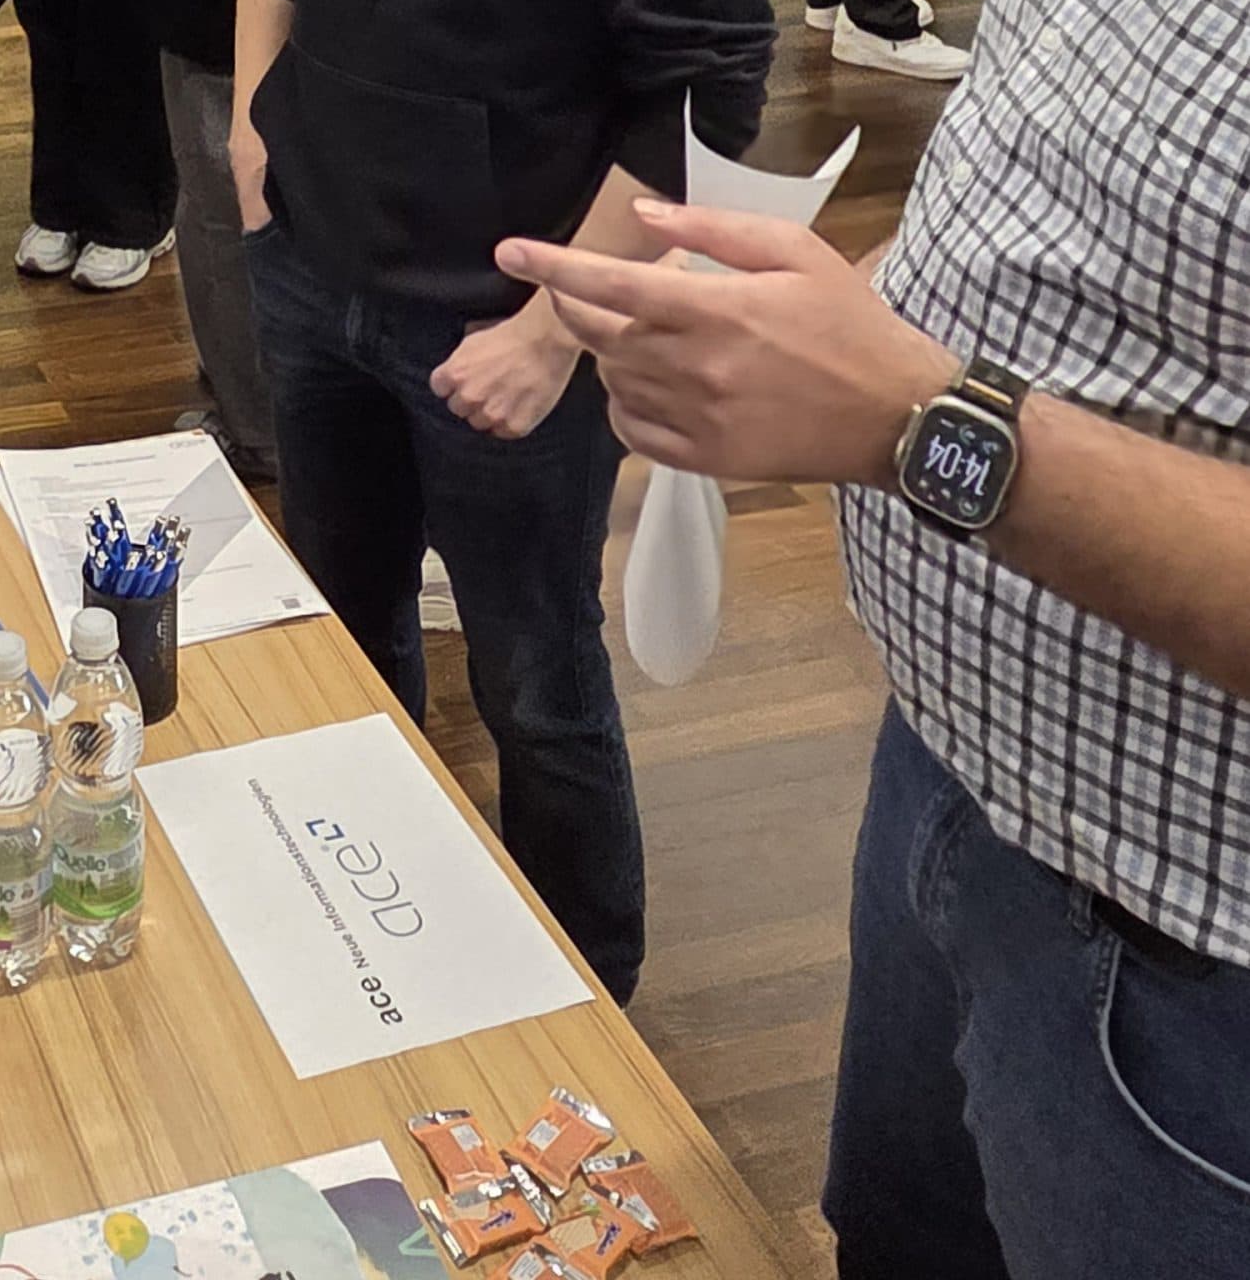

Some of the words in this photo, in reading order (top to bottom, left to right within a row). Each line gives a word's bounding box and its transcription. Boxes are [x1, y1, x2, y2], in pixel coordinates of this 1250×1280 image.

[924, 433, 992, 497] 14:04
[248, 778, 346, 933] Informationstechnologien
[341, 933, 370, 970] Neue
[360, 975, 404, 1026] ace
